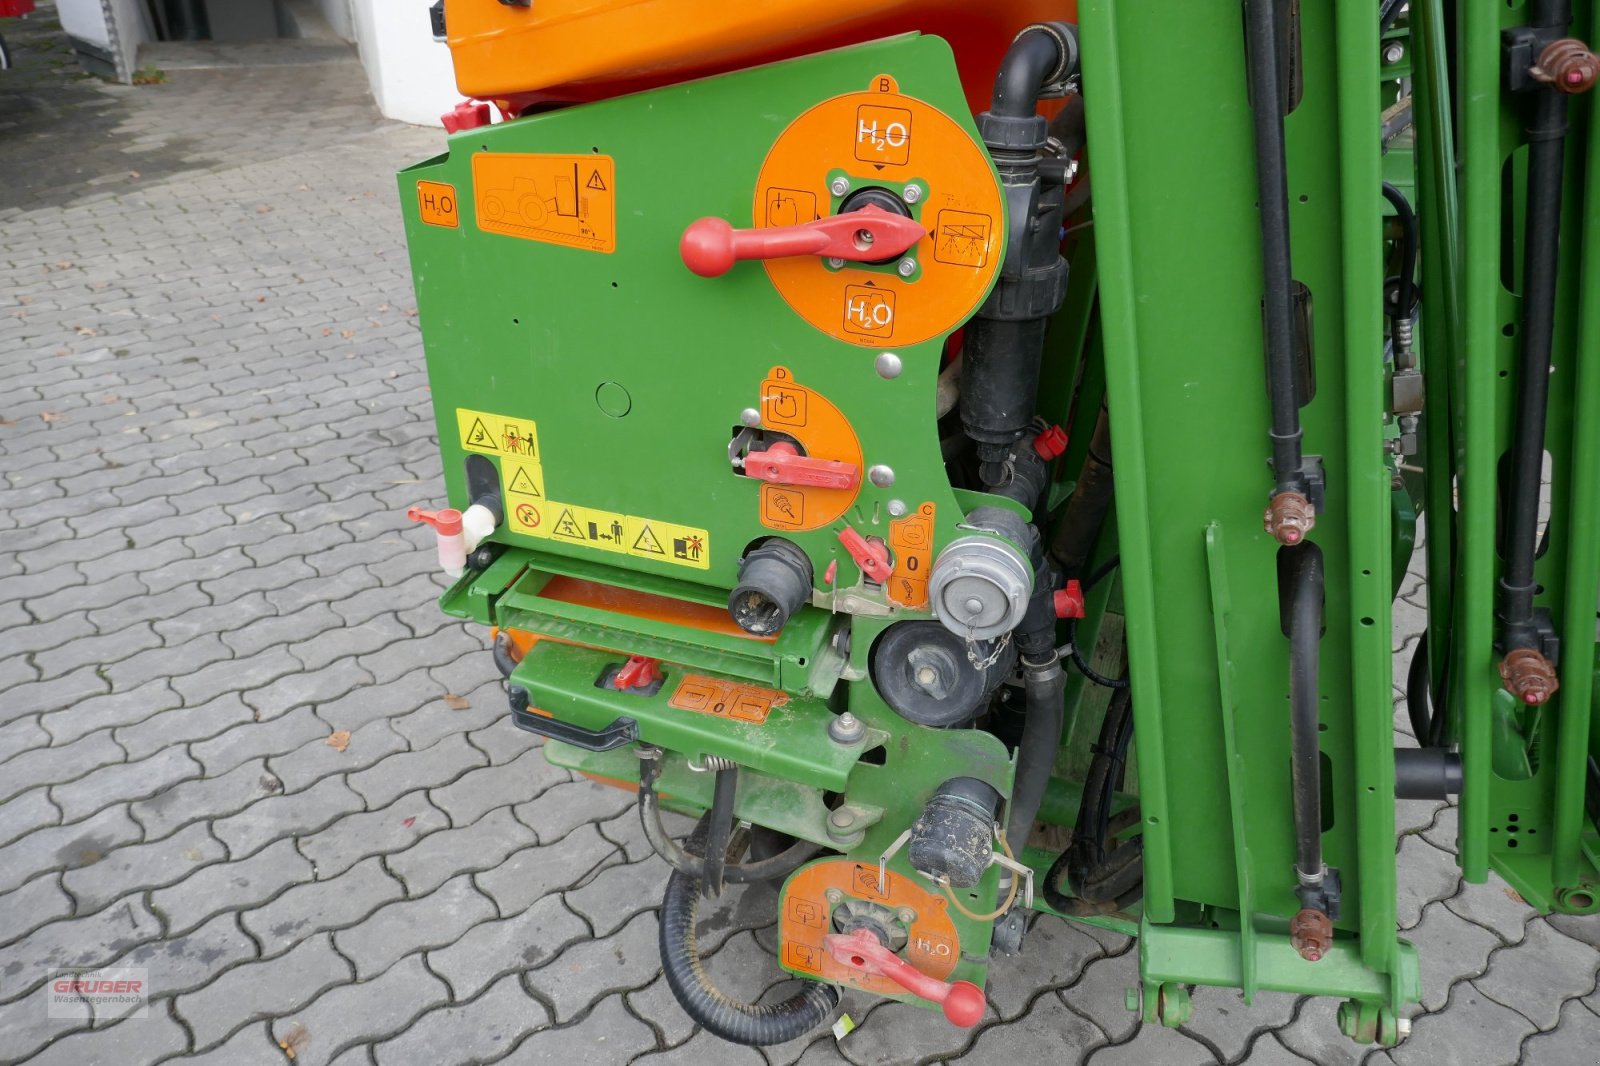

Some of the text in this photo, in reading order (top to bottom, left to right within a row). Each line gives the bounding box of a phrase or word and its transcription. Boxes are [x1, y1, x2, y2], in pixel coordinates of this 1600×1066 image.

[880, 78, 890, 93] B
[858, 119, 907, 151] H2O
[423, 193, 453, 217] H2O
[847, 299, 892, 328] H2O
[776, 368, 786, 379] D
[922, 505, 932, 516] C
[907, 556, 919, 571] 0
[713, 702, 725, 714] 0
